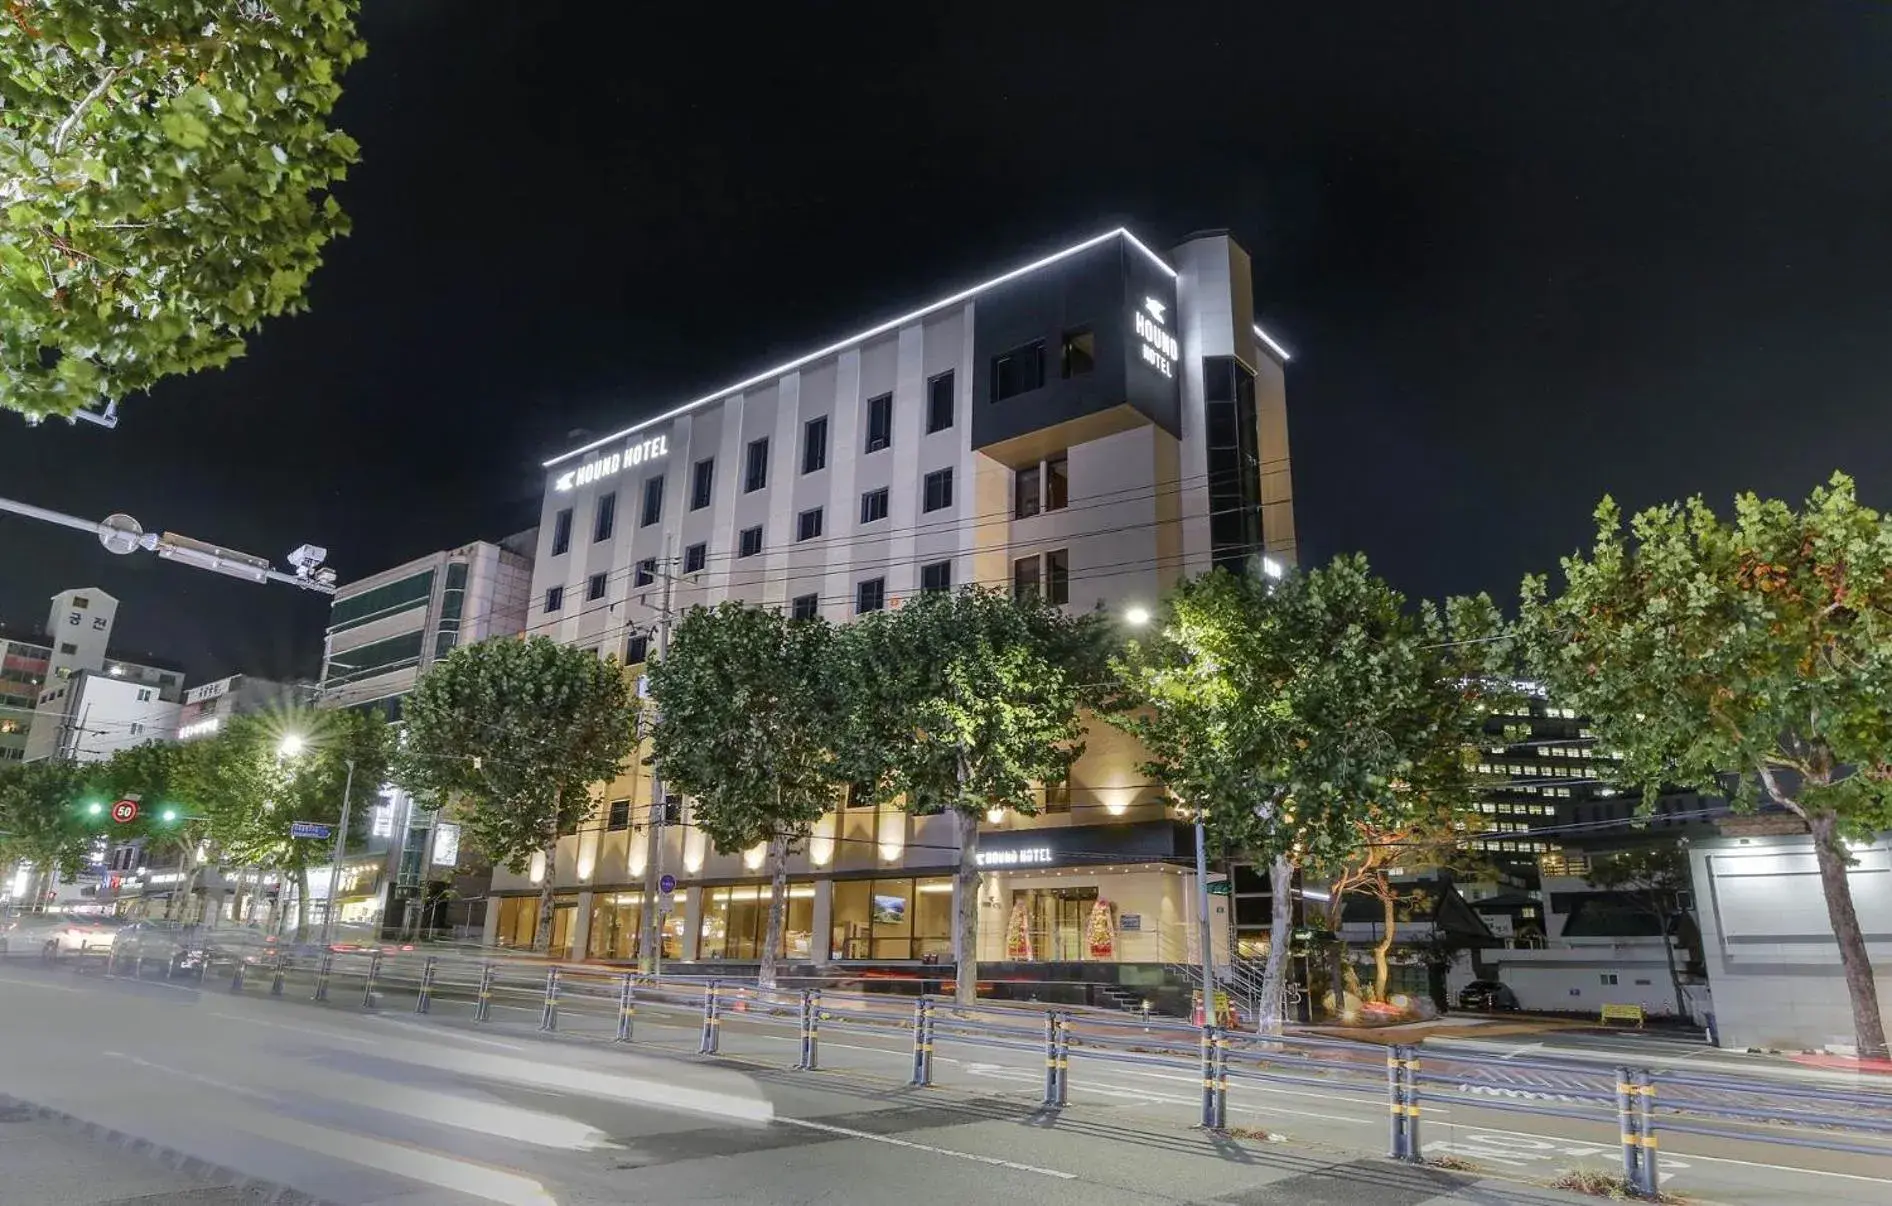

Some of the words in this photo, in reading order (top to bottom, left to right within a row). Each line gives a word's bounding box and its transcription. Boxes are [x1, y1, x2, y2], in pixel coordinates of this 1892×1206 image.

[1135, 311, 1178, 361] HOUND
[1143, 343, 1172, 378] HOTEL
[575, 453, 620, 487] HOUND
[622, 435, 668, 469] HOTEL
[985, 850, 1018, 865] HOUND
[1020, 848, 1052, 863] HOTEL
